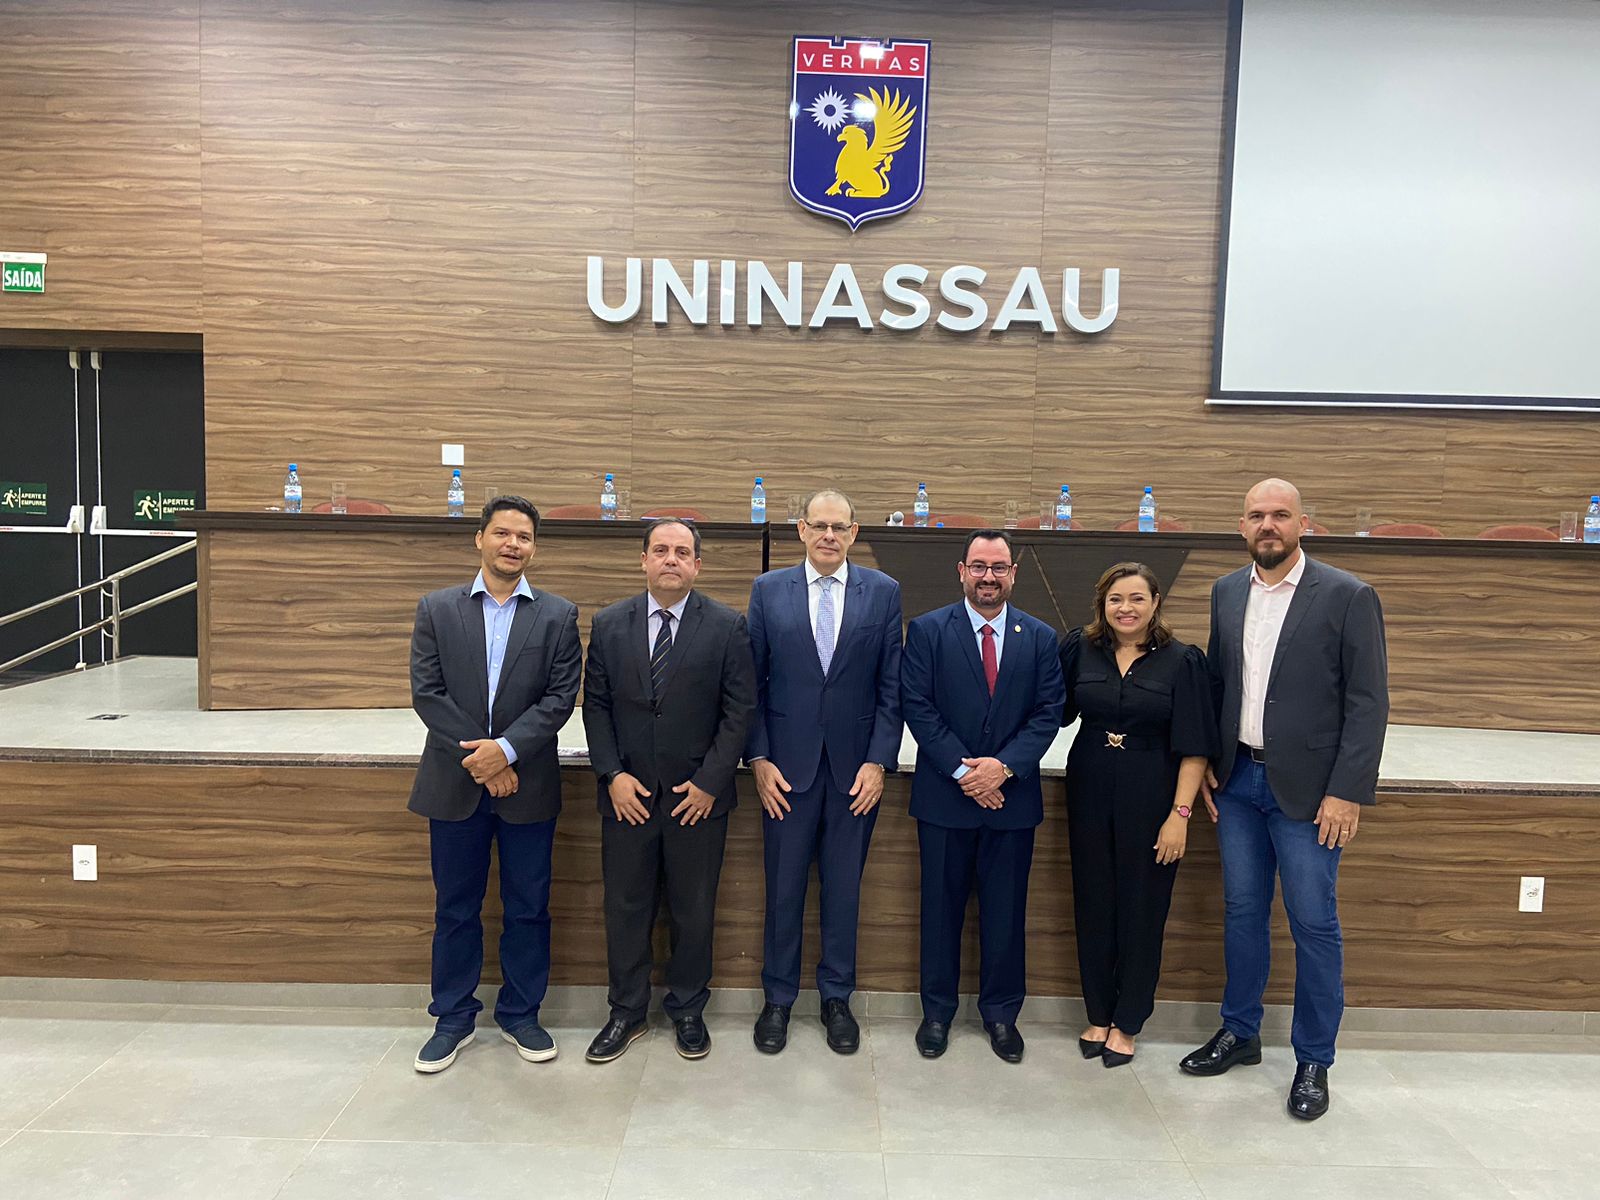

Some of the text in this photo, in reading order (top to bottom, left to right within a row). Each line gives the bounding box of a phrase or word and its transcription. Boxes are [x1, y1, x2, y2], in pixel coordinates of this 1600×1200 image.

[5, 268, 42, 287] SAÍDA
[586, 256, 1120, 333] UNINASSAU
[21, 499, 46, 507] EMPURRE
[162, 498, 189, 506] APERTE
